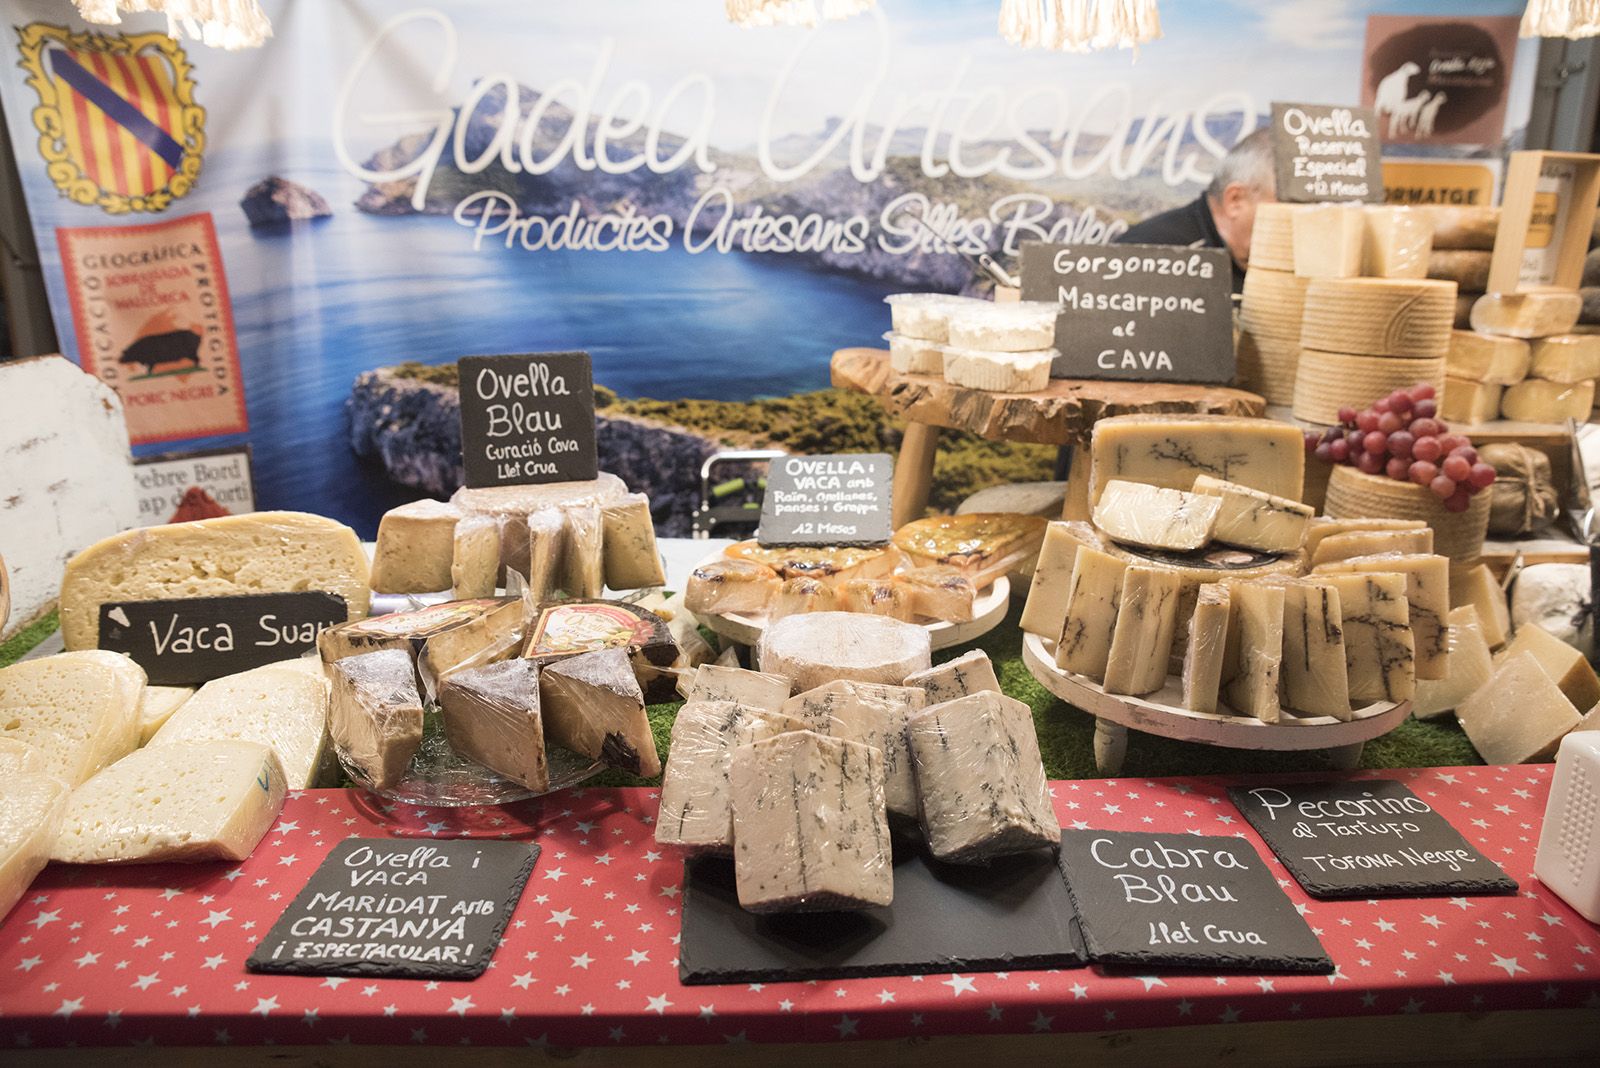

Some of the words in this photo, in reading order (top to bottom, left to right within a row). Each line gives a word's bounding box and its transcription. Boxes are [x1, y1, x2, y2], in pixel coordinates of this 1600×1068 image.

[333, 8, 717, 211] Gadea
[757, 3, 1257, 187] Artesans
[1283, 108, 1371, 138] Ovella
[1294, 135, 1366, 156] Reserva
[1292, 156, 1367, 181] Especial
[1304, 181, 1330, 196] +12
[1383, 187, 1480, 205] ORMATGE
[453, 190, 673, 252] Productes
[683, 187, 869, 254] Artesans
[1053, 249, 1214, 280] Gorgonzola
[1058, 286, 1206, 317] Mascarpone
[194, 262, 229, 396] PROTEGIDA
[1112, 320, 1136, 337] al
[1097, 349, 1173, 371] CAVA
[476, 362, 570, 400] Ovella
[486, 402, 562, 437] Blau
[485, 438, 542, 460] Curació
[547, 436, 579, 454] Cova
[134, 467, 188, 489] ebre
[498, 461, 520, 479] Llet
[524, 460, 558, 476] Crua
[785, 458, 865, 476] OVELLA
[794, 476, 841, 490] VACA
[846, 478, 874, 488] amb
[138, 496, 167, 516] ap
[775, 503, 820, 516] panses
[833, 502, 879, 514] Grappa
[791, 523, 814, 534] 12
[817, 523, 857, 535] Mesos
[149, 613, 234, 655] Vaca
[1248, 787, 1433, 821] Pecorino
[1292, 821, 1318, 839] al
[344, 846, 451, 868] Ovella
[471, 850, 482, 869] i
[1090, 838, 1249, 869] Cabra
[1401, 847, 1476, 872] Negre
[350, 869, 428, 887] VACA
[1113, 873, 1238, 904] Blau
[290, 916, 466, 940] CASTANYA
[1149, 921, 1199, 945] Llet
[1203, 924, 1267, 945] Crua
[272, 940, 287, 959] i
[293, 942, 474, 964] ESPECTACULAR!
